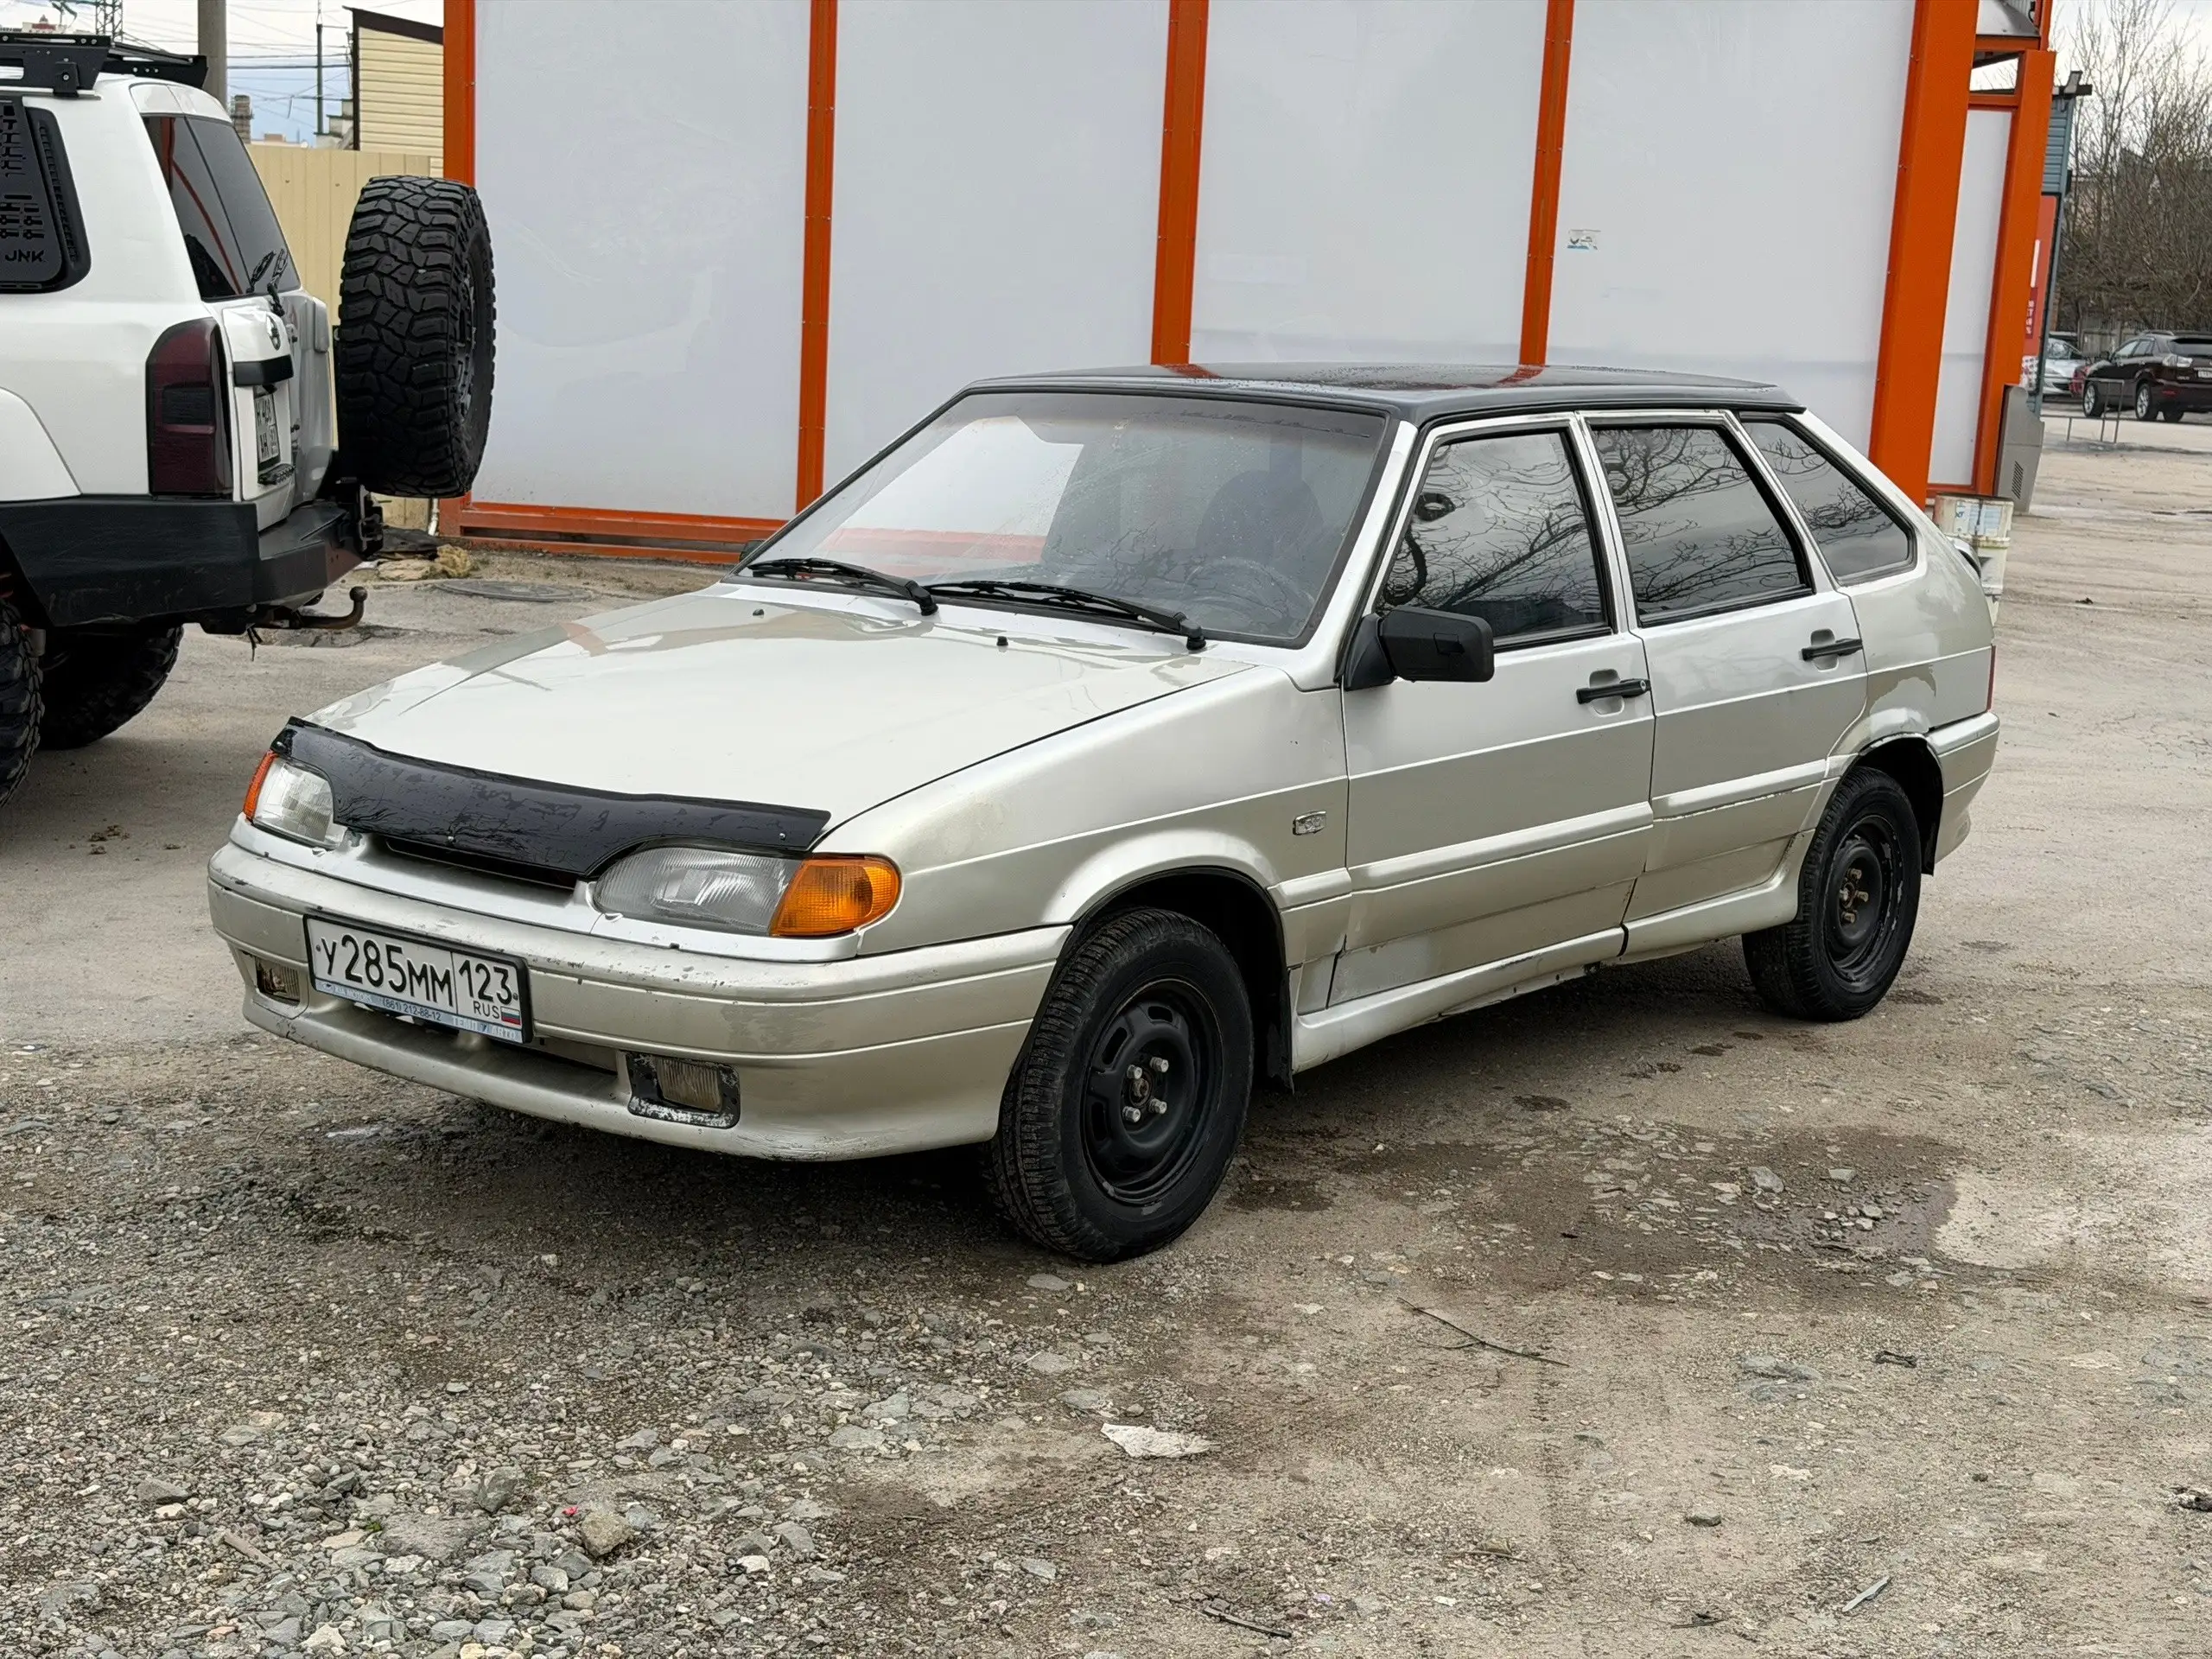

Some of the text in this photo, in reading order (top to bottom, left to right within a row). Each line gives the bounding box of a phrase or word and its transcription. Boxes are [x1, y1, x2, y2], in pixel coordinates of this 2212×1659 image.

[4, 249, 44, 263] JNK
[459, 959, 512, 1005] 123
[473, 1000, 500, 1020] RUS
